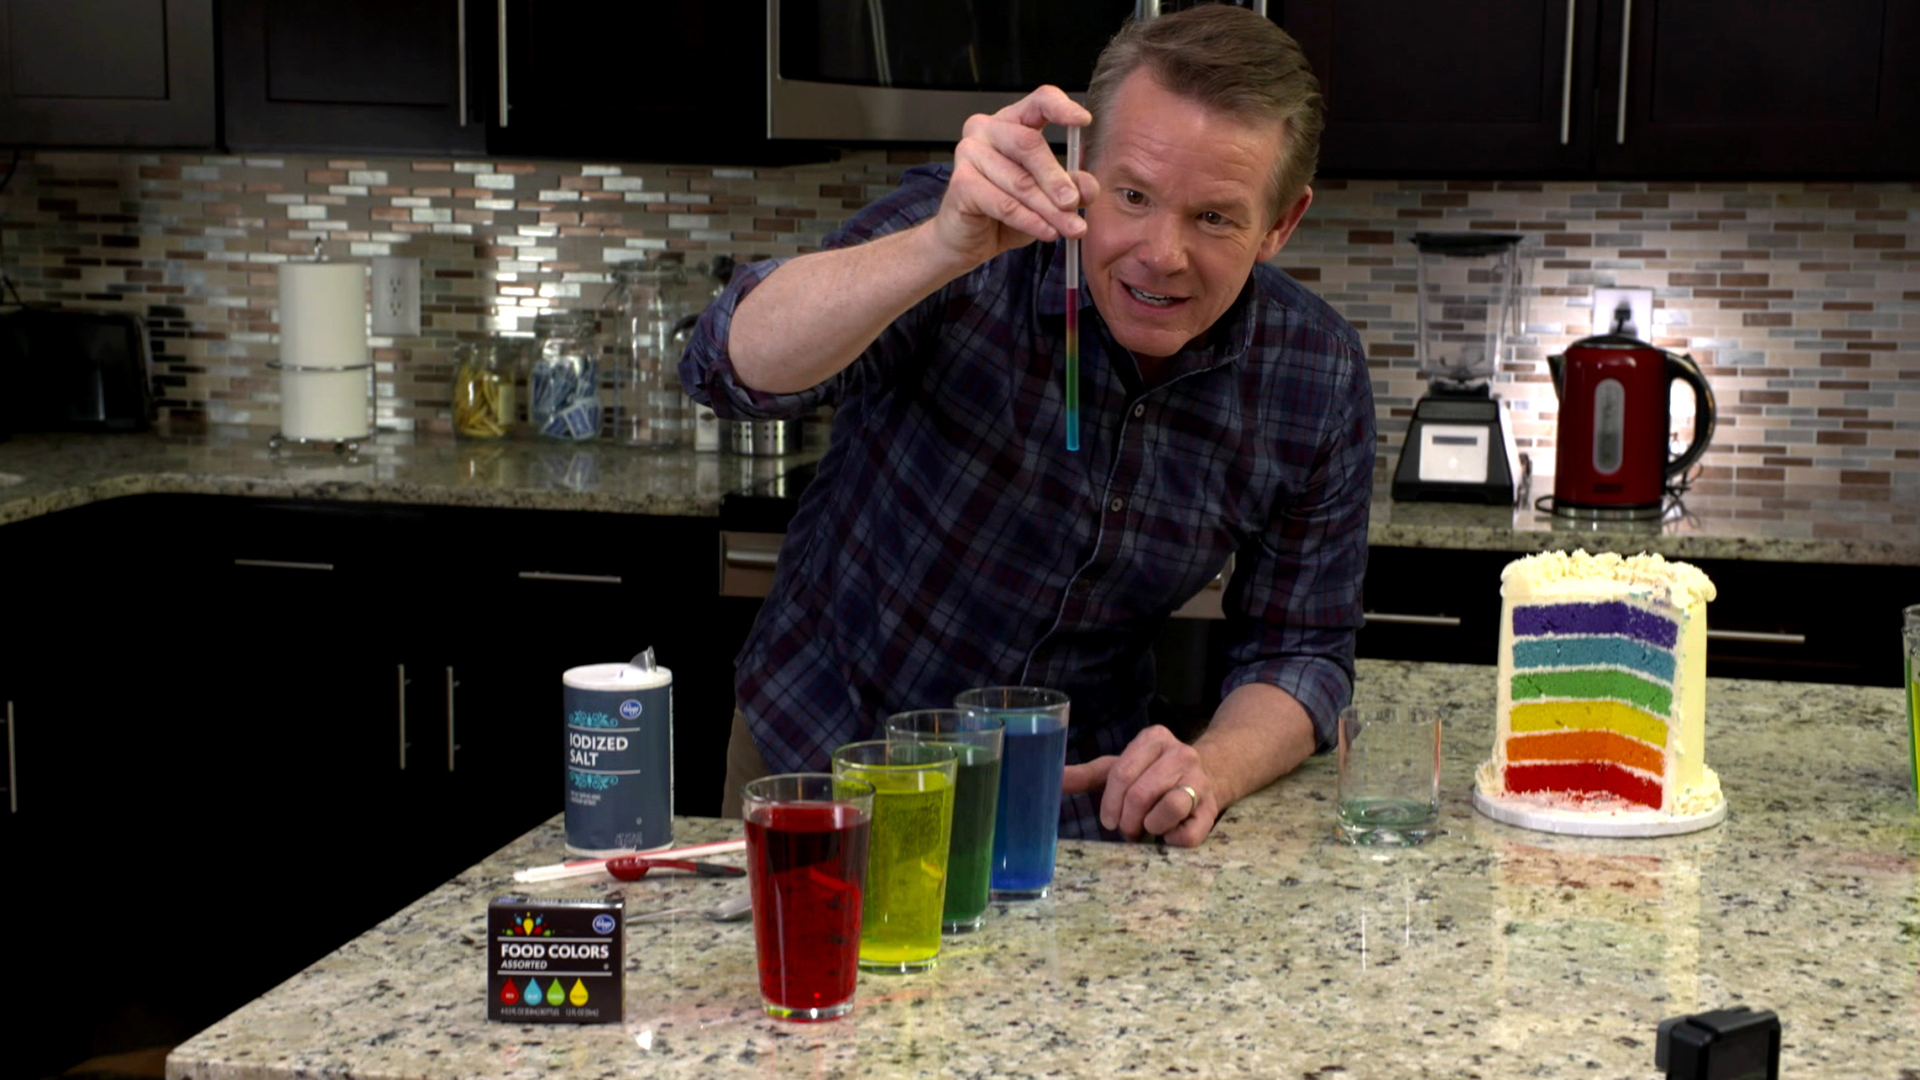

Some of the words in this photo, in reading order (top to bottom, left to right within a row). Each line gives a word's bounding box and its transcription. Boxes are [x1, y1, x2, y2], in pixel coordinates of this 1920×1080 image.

[569, 732, 629, 751] IODIZED
[569, 748, 599, 767] SALT
[501, 943, 545, 959] FOOD
[548, 944, 609, 959] COLORS
[500, 959, 548, 970] ASSORTED
